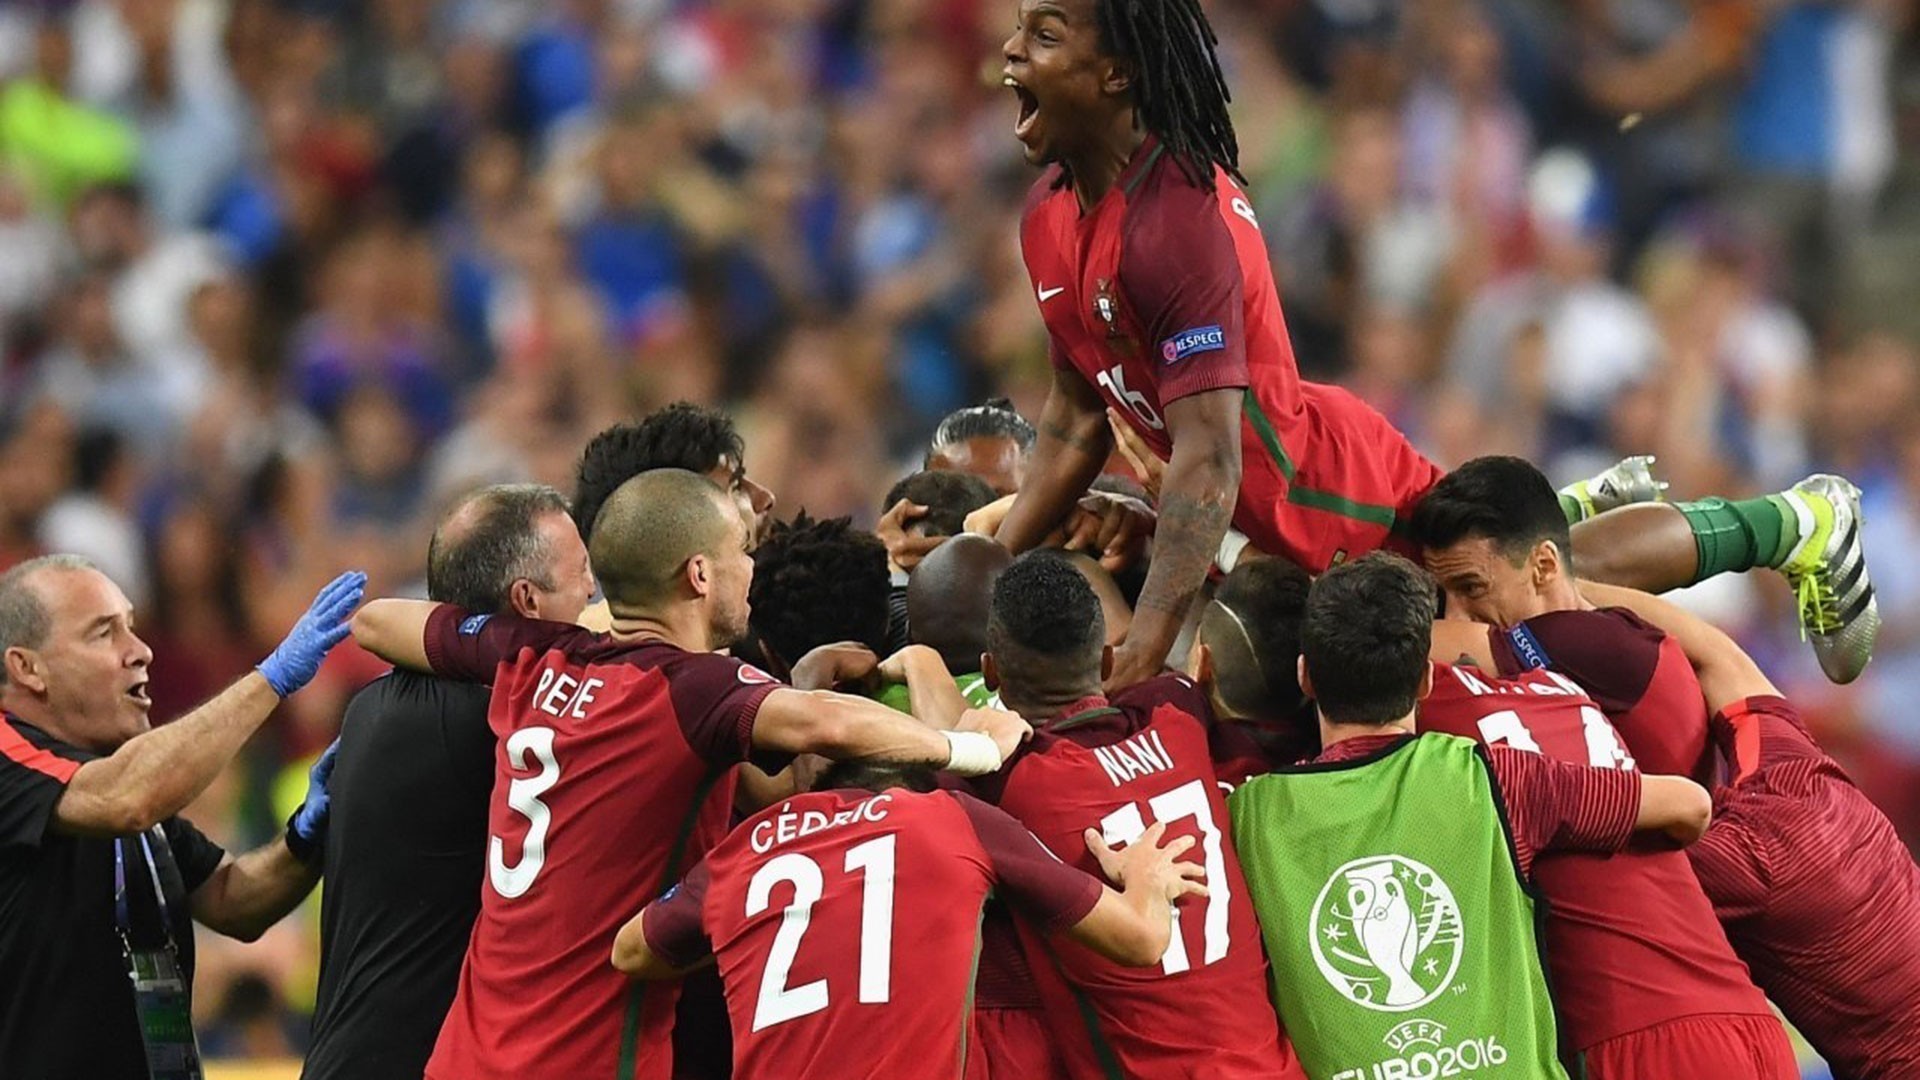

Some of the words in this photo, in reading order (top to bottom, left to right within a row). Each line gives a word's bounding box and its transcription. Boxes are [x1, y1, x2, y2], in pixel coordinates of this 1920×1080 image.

[1175, 331, 1222, 352] RESPECT
[1096, 364, 1164, 430] 16
[532, 668, 604, 718] PEE
[1093, 730, 1174, 787] NANI
[489, 726, 560, 898] 3
[751, 794, 892, 853] CÉDRIC
[1100, 779, 1231, 976] 17
[745, 833, 896, 1034] 21
[1387, 1023, 1442, 1050] UEFA
